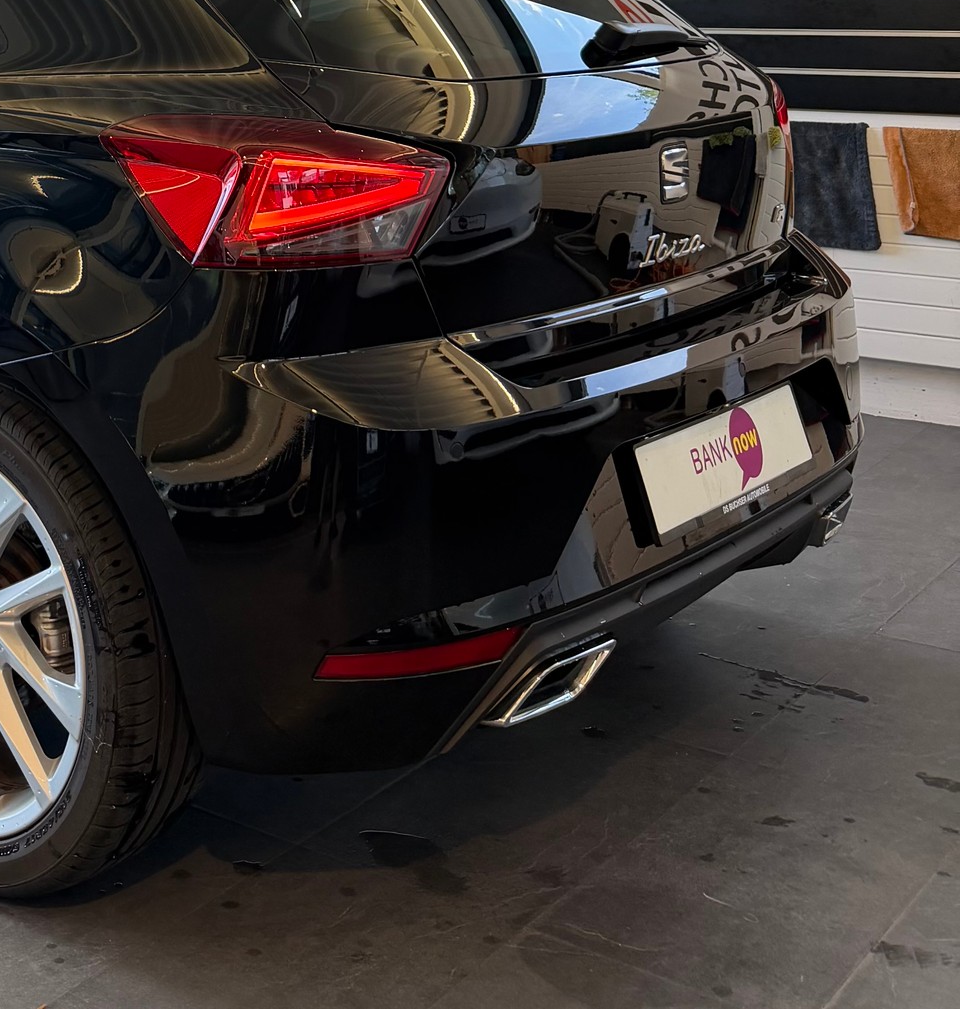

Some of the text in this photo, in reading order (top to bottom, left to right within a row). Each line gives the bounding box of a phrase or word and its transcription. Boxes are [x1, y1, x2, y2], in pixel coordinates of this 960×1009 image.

[639, 232, 705, 268] Ibiza
[690, 428, 758, 475] BANK now
